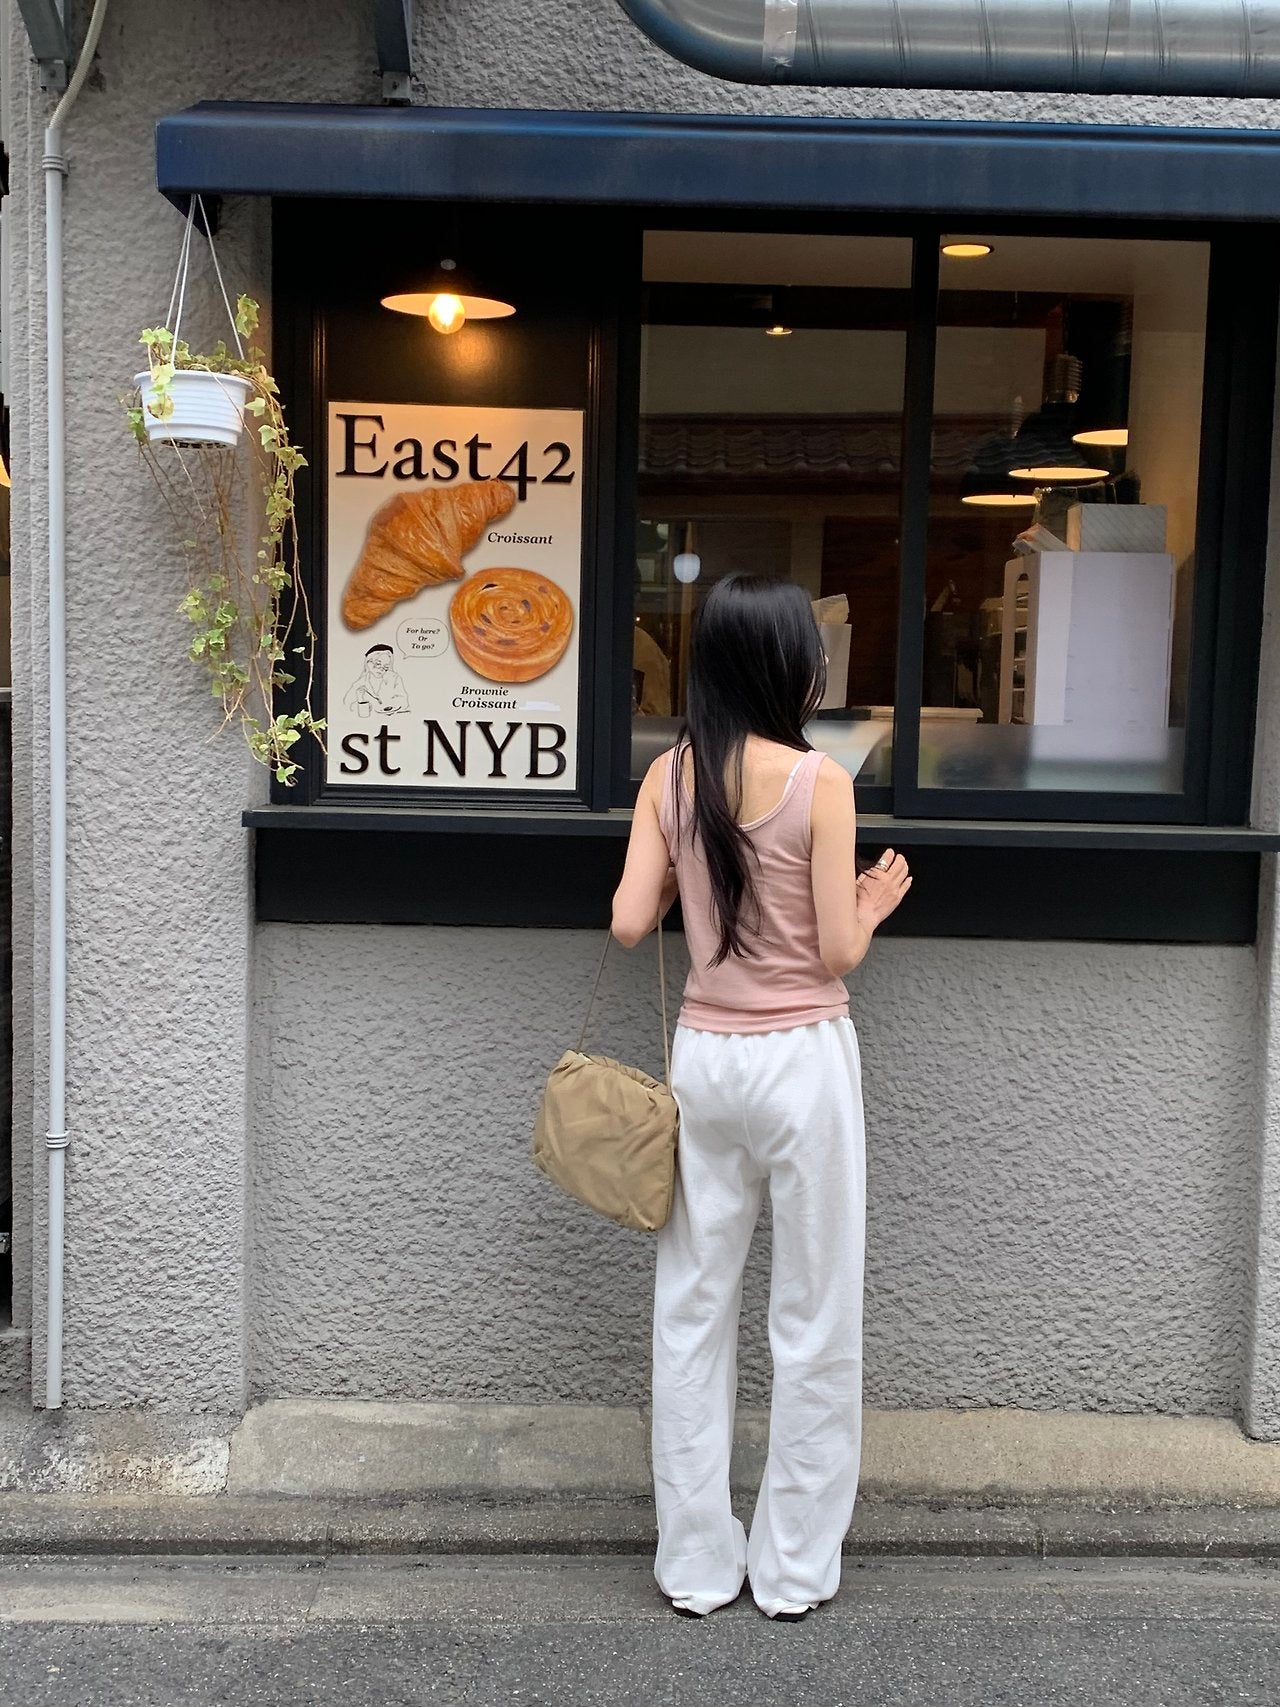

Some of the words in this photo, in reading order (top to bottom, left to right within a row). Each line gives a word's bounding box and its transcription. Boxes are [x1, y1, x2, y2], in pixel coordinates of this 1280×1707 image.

[488, 532, 553, 545] Croissant
[420, 627, 440, 635] here?
[421, 643, 434, 651] go?
[460, 686, 509, 696] Brownie
[451, 697, 517, 710] Croissant
[340, 725, 401, 775] st
[423, 719, 567, 779] NYB
